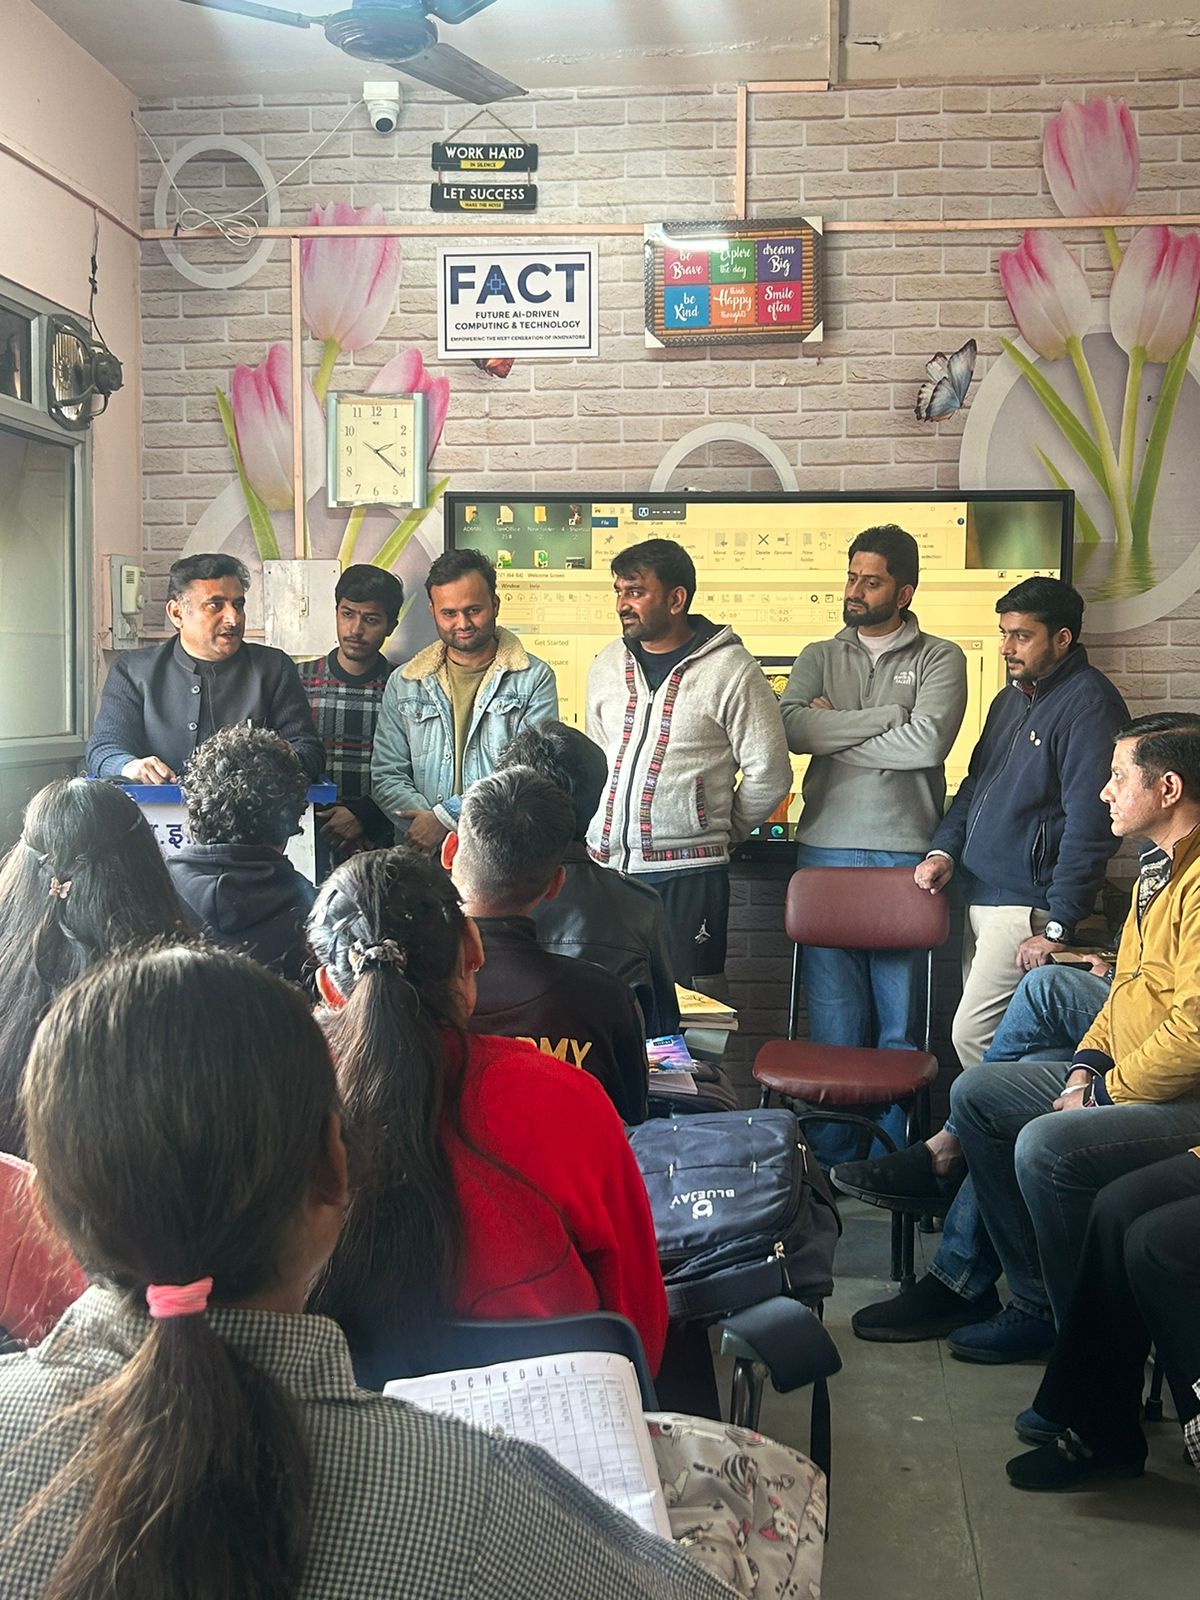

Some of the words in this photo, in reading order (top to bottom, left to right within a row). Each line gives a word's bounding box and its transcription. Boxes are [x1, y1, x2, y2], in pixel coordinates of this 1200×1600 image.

[445, 146, 484, 159] WORK
[489, 147, 525, 159] HARD
[443, 187, 466, 199] LET
[470, 188, 525, 200] SUCCESS
[679, 250, 693, 261] be
[719, 246, 752, 264] Explore
[763, 243, 795, 256] dream
[669, 261, 704, 280] Brave
[718, 262, 731, 274] the
[732, 262, 747, 279] day
[767, 255, 791, 276] Big
[449, 262, 585, 305] FACT
[683, 292, 697, 305] be
[713, 288, 752, 311] Happy
[764, 285, 794, 302] Smile
[475, 311, 510, 319] FUTURE
[512, 310, 560, 318] AI-DRIVEN
[674, 302, 700, 322] Kind
[767, 301, 791, 321] often
[454, 322, 510, 330] COMPUTING
[511, 321, 518, 329] &
[520, 320, 581, 329] TECHNOLOGY
[353, 407, 362, 418] 11
[371, 406, 382, 417] 12
[393, 408, 398, 419] 1
[345, 425, 355, 436] 10
[400, 425, 407, 436] 2
[346, 446, 353, 456] 9
[400, 446, 407, 457] 3
[346, 466, 353, 477] 8
[399, 467, 406, 477] 4
[355, 484, 361, 495] 7
[373, 486, 379, 497] 6
[392, 485, 399, 496] 5
[549, 659, 569, 667] kspace
[514, 1036, 593, 1070] MY
[669, 1188, 735, 1210] BLUEJAY
[450, 1360, 576, 1392] SCHEDULE
